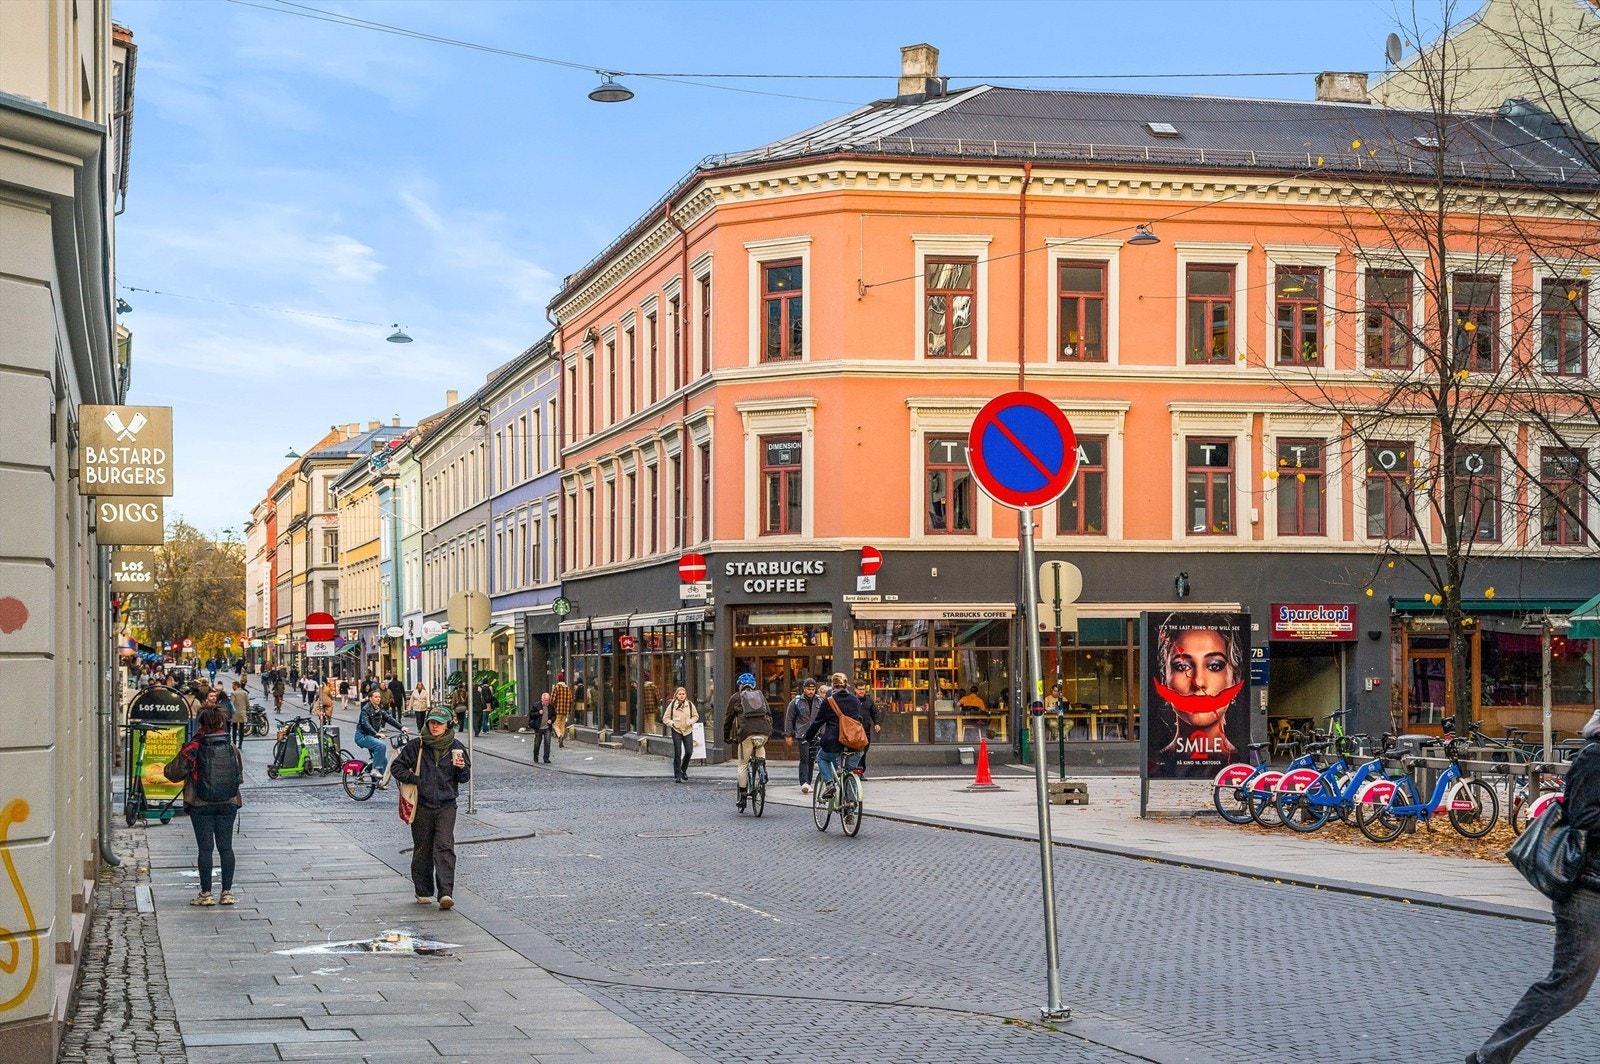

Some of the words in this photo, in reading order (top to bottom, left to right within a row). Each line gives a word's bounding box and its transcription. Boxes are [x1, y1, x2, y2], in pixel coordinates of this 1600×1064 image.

[768, 442, 802, 450] DIMENSION
[86, 446, 166, 465] BASTARD
[86, 466, 166, 485] BURGERS
[100, 502, 159, 523] DIGG
[121, 561, 144, 571] LOS
[725, 560, 825, 576] STARBUCKS
[114, 571, 151, 582] TACOS
[743, 578, 806, 593] COFFEE
[1280, 605, 1349, 623] Sparekopi
[139, 704, 154, 712] LOS
[155, 704, 180, 712] TACOS
[1176, 737, 1222, 753] SMILE
